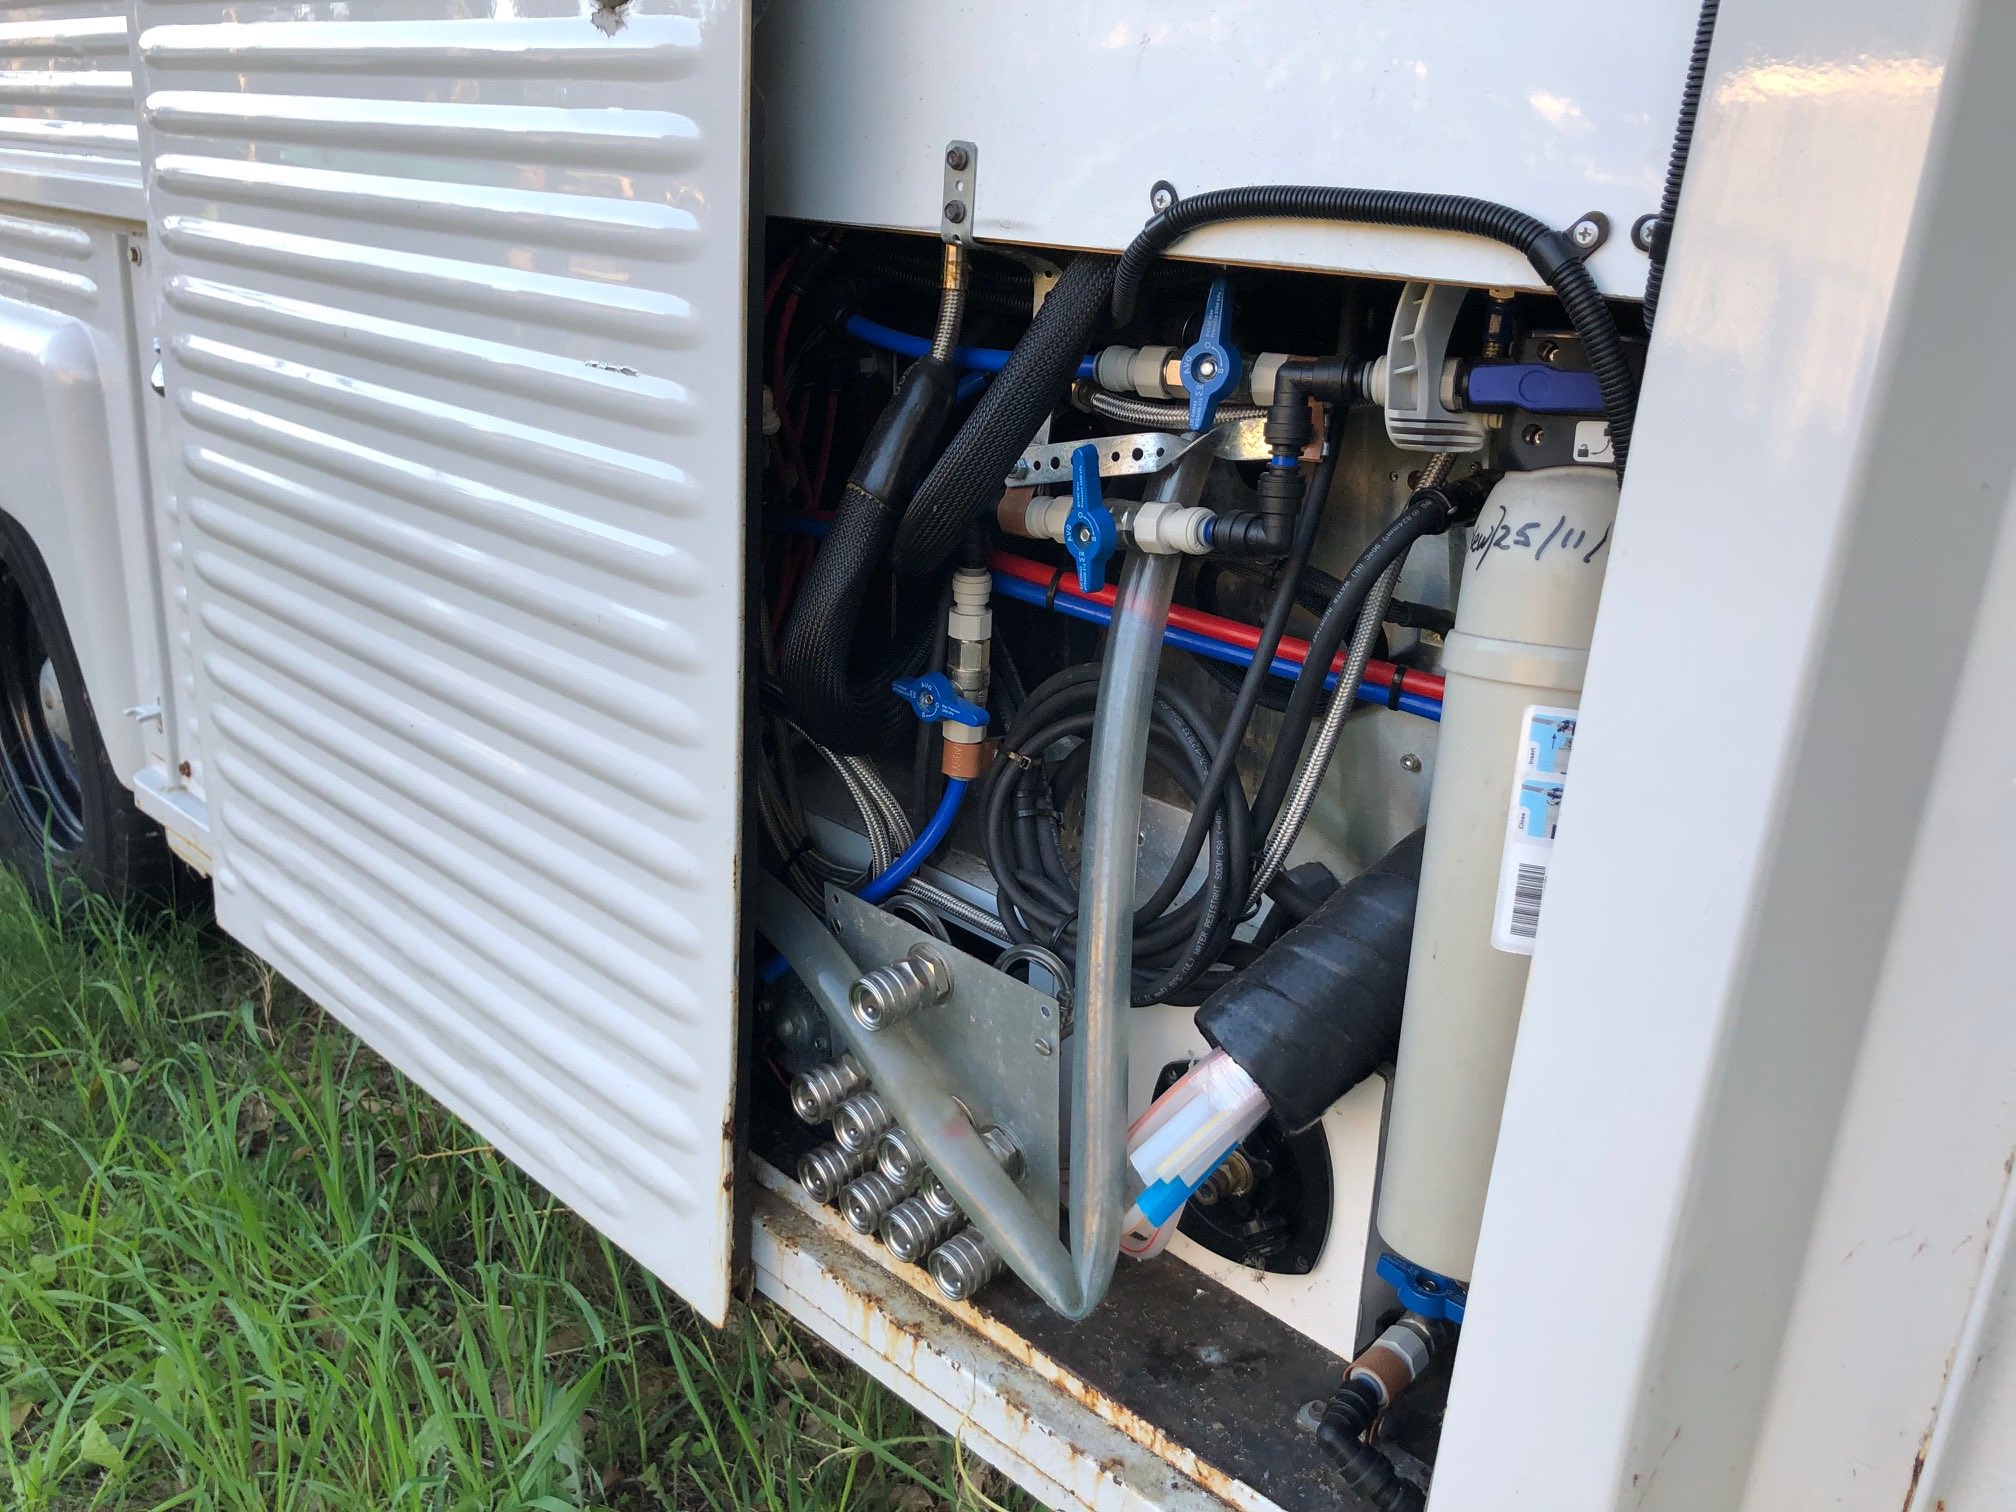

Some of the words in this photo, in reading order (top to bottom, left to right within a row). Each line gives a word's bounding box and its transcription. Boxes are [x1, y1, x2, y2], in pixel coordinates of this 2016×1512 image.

[1183, 355, 1193, 375] AVG
[1065, 523, 1073, 542] AVG
[1351, 563, 1364, 578] (UL)
[1332, 580, 1351, 605] WATER
[1312, 606, 1333, 643] RESISTANT
[920, 681, 933, 691] AVG
[1528, 746, 1536, 765] Insert
[1518, 811, 1526, 830] Close
[1182, 957, 1196, 978] (UL)
[1194, 931, 1208, 956] WATER
[1204, 884, 1223, 929] RESISTANT
[1214, 861, 1223, 880] SOOW
